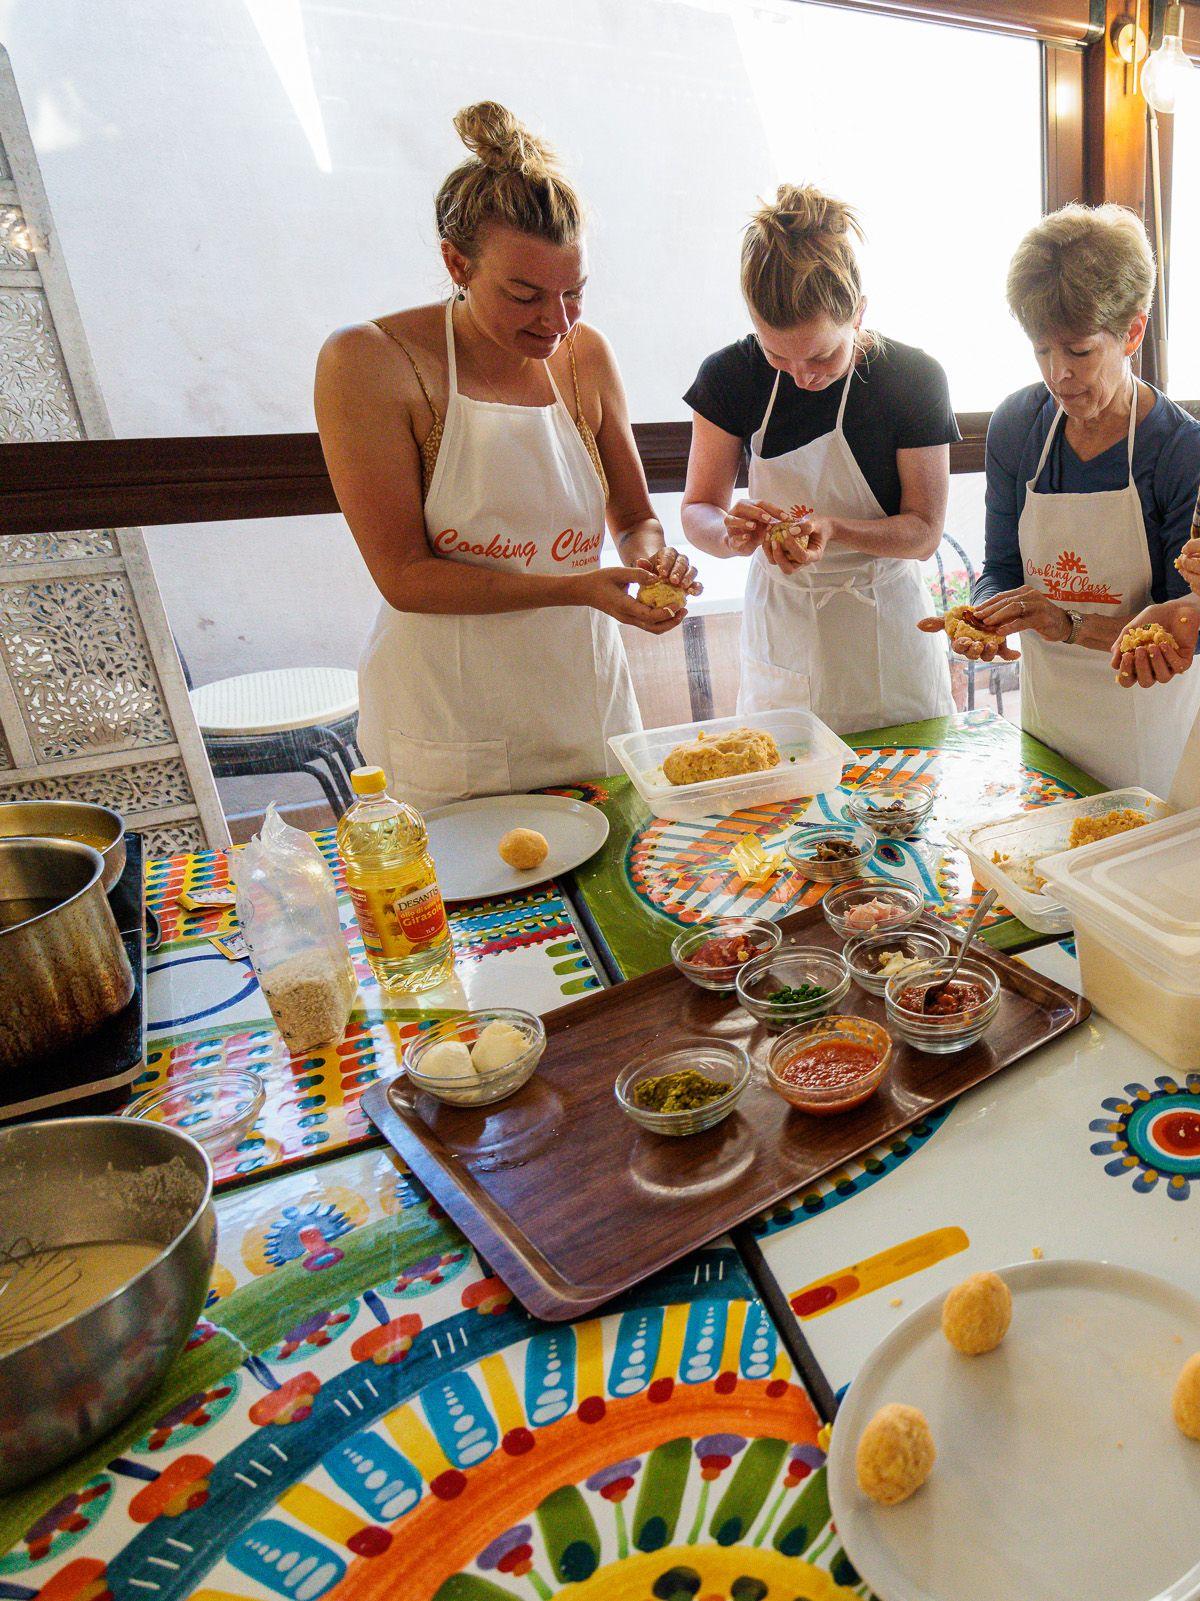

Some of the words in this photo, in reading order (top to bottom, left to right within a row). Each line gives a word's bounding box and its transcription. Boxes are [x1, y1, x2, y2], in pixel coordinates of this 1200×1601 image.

[434, 528, 538, 567] Cooking
[550, 527, 601, 562] Class
[1026, 558, 1072, 589] Cooking
[1069, 575, 1112, 595] Class
